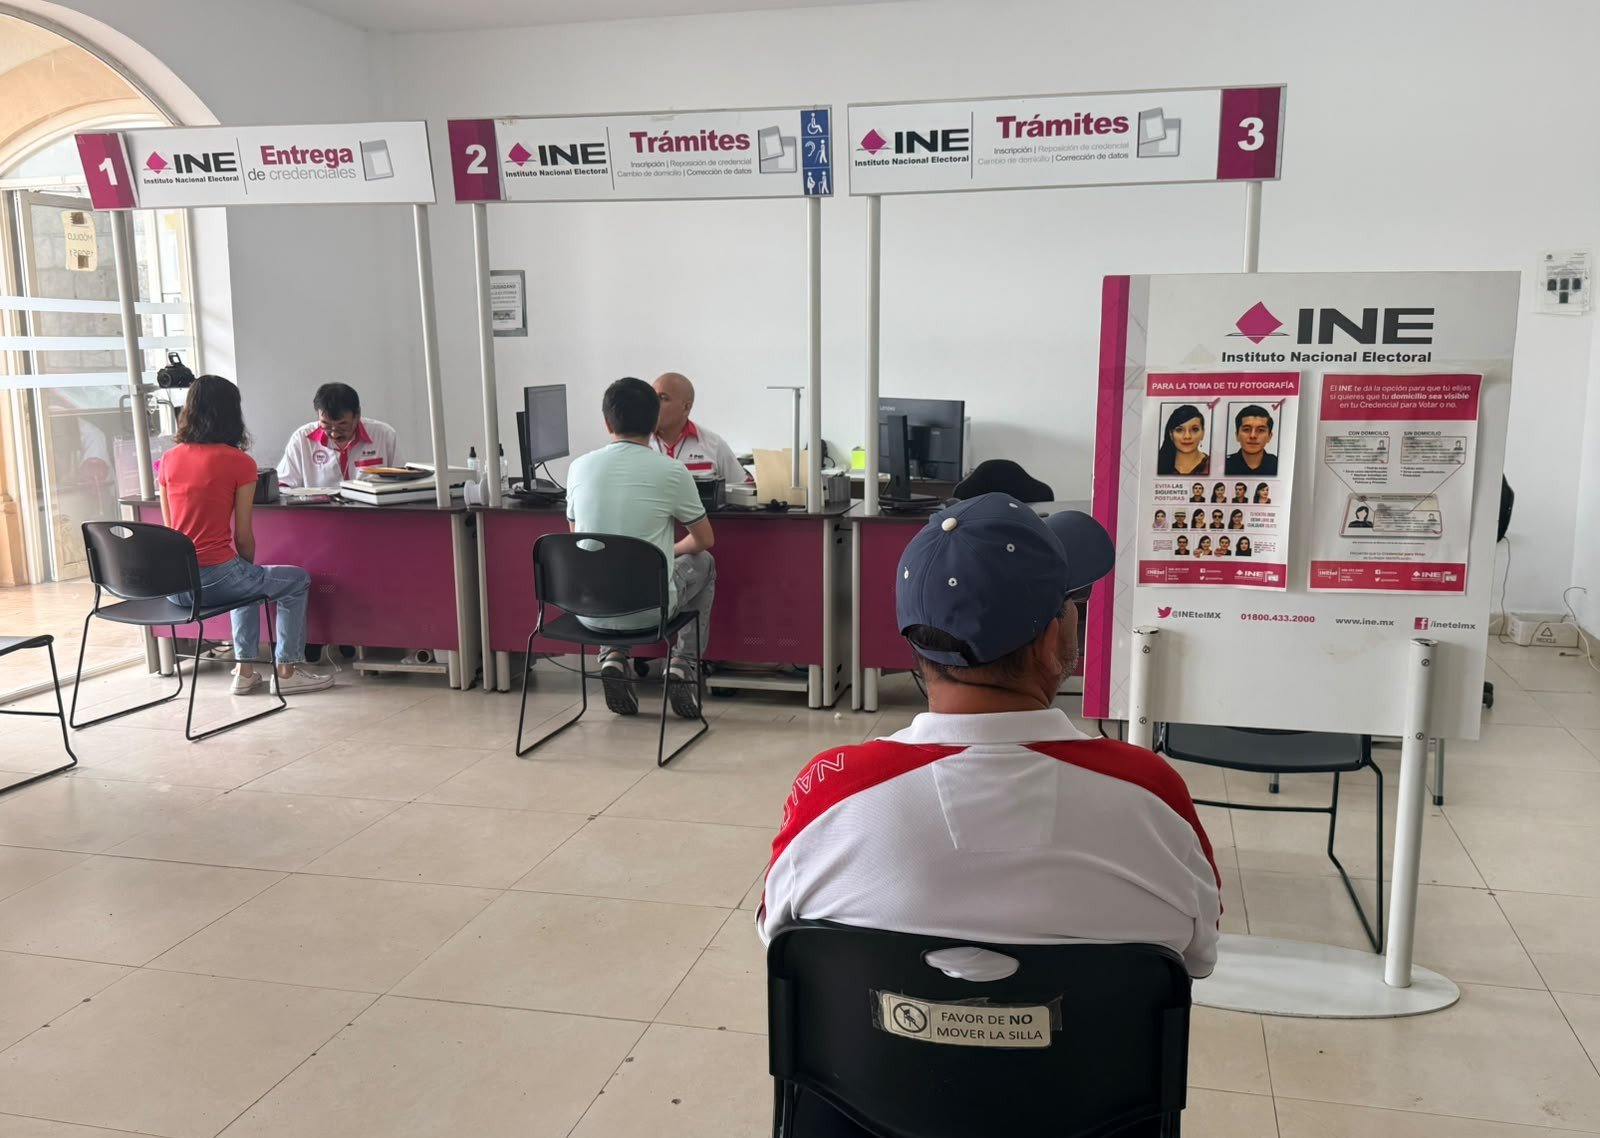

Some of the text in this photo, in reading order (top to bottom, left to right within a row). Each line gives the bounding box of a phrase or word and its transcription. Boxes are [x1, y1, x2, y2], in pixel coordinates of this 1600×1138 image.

[996, 112, 1130, 139] Trámites
[1237, 116, 1265, 151] 3
[629, 130, 750, 154] Trámites
[894, 128, 969, 154] INE
[538, 142, 607, 166] INE
[994, 147, 1032, 155] Inscripción
[1038, 144, 1079, 153] Reposición
[1091, 142, 1130, 150] credencial
[260, 144, 354, 168] Entrega
[465, 144, 488, 174] 2
[854, 155, 969, 167] Instituto Nacional Electoral
[978, 158, 1006, 166] Cambio
[1056, 154, 1096, 162] Corrección
[173, 152, 238, 174] INE
[630, 161, 665, 169] Inscripción
[670, 160, 706, 168] Reposición
[98, 158, 119, 186] 1
[248, 166, 356, 181] de credenciales
[686, 168, 722, 176] Corrección
[1297, 308, 1434, 344] INE
[1222, 351, 1432, 363] Instituto Nacional Electoral
[1240, 380, 1294, 389] FOTOGRAFÍA
[1172, 610, 1221, 619] @INEtelMX
[1240, 613, 1315, 623] 01800.433.2000
[1335, 618, 1394, 626] www.ine.mx
[1430, 621, 1476, 630] /inetelmx
[942, 1012, 1033, 1025] FAVOR DE NO
[937, 1027, 1043, 1040] MOVER LA SILLA
